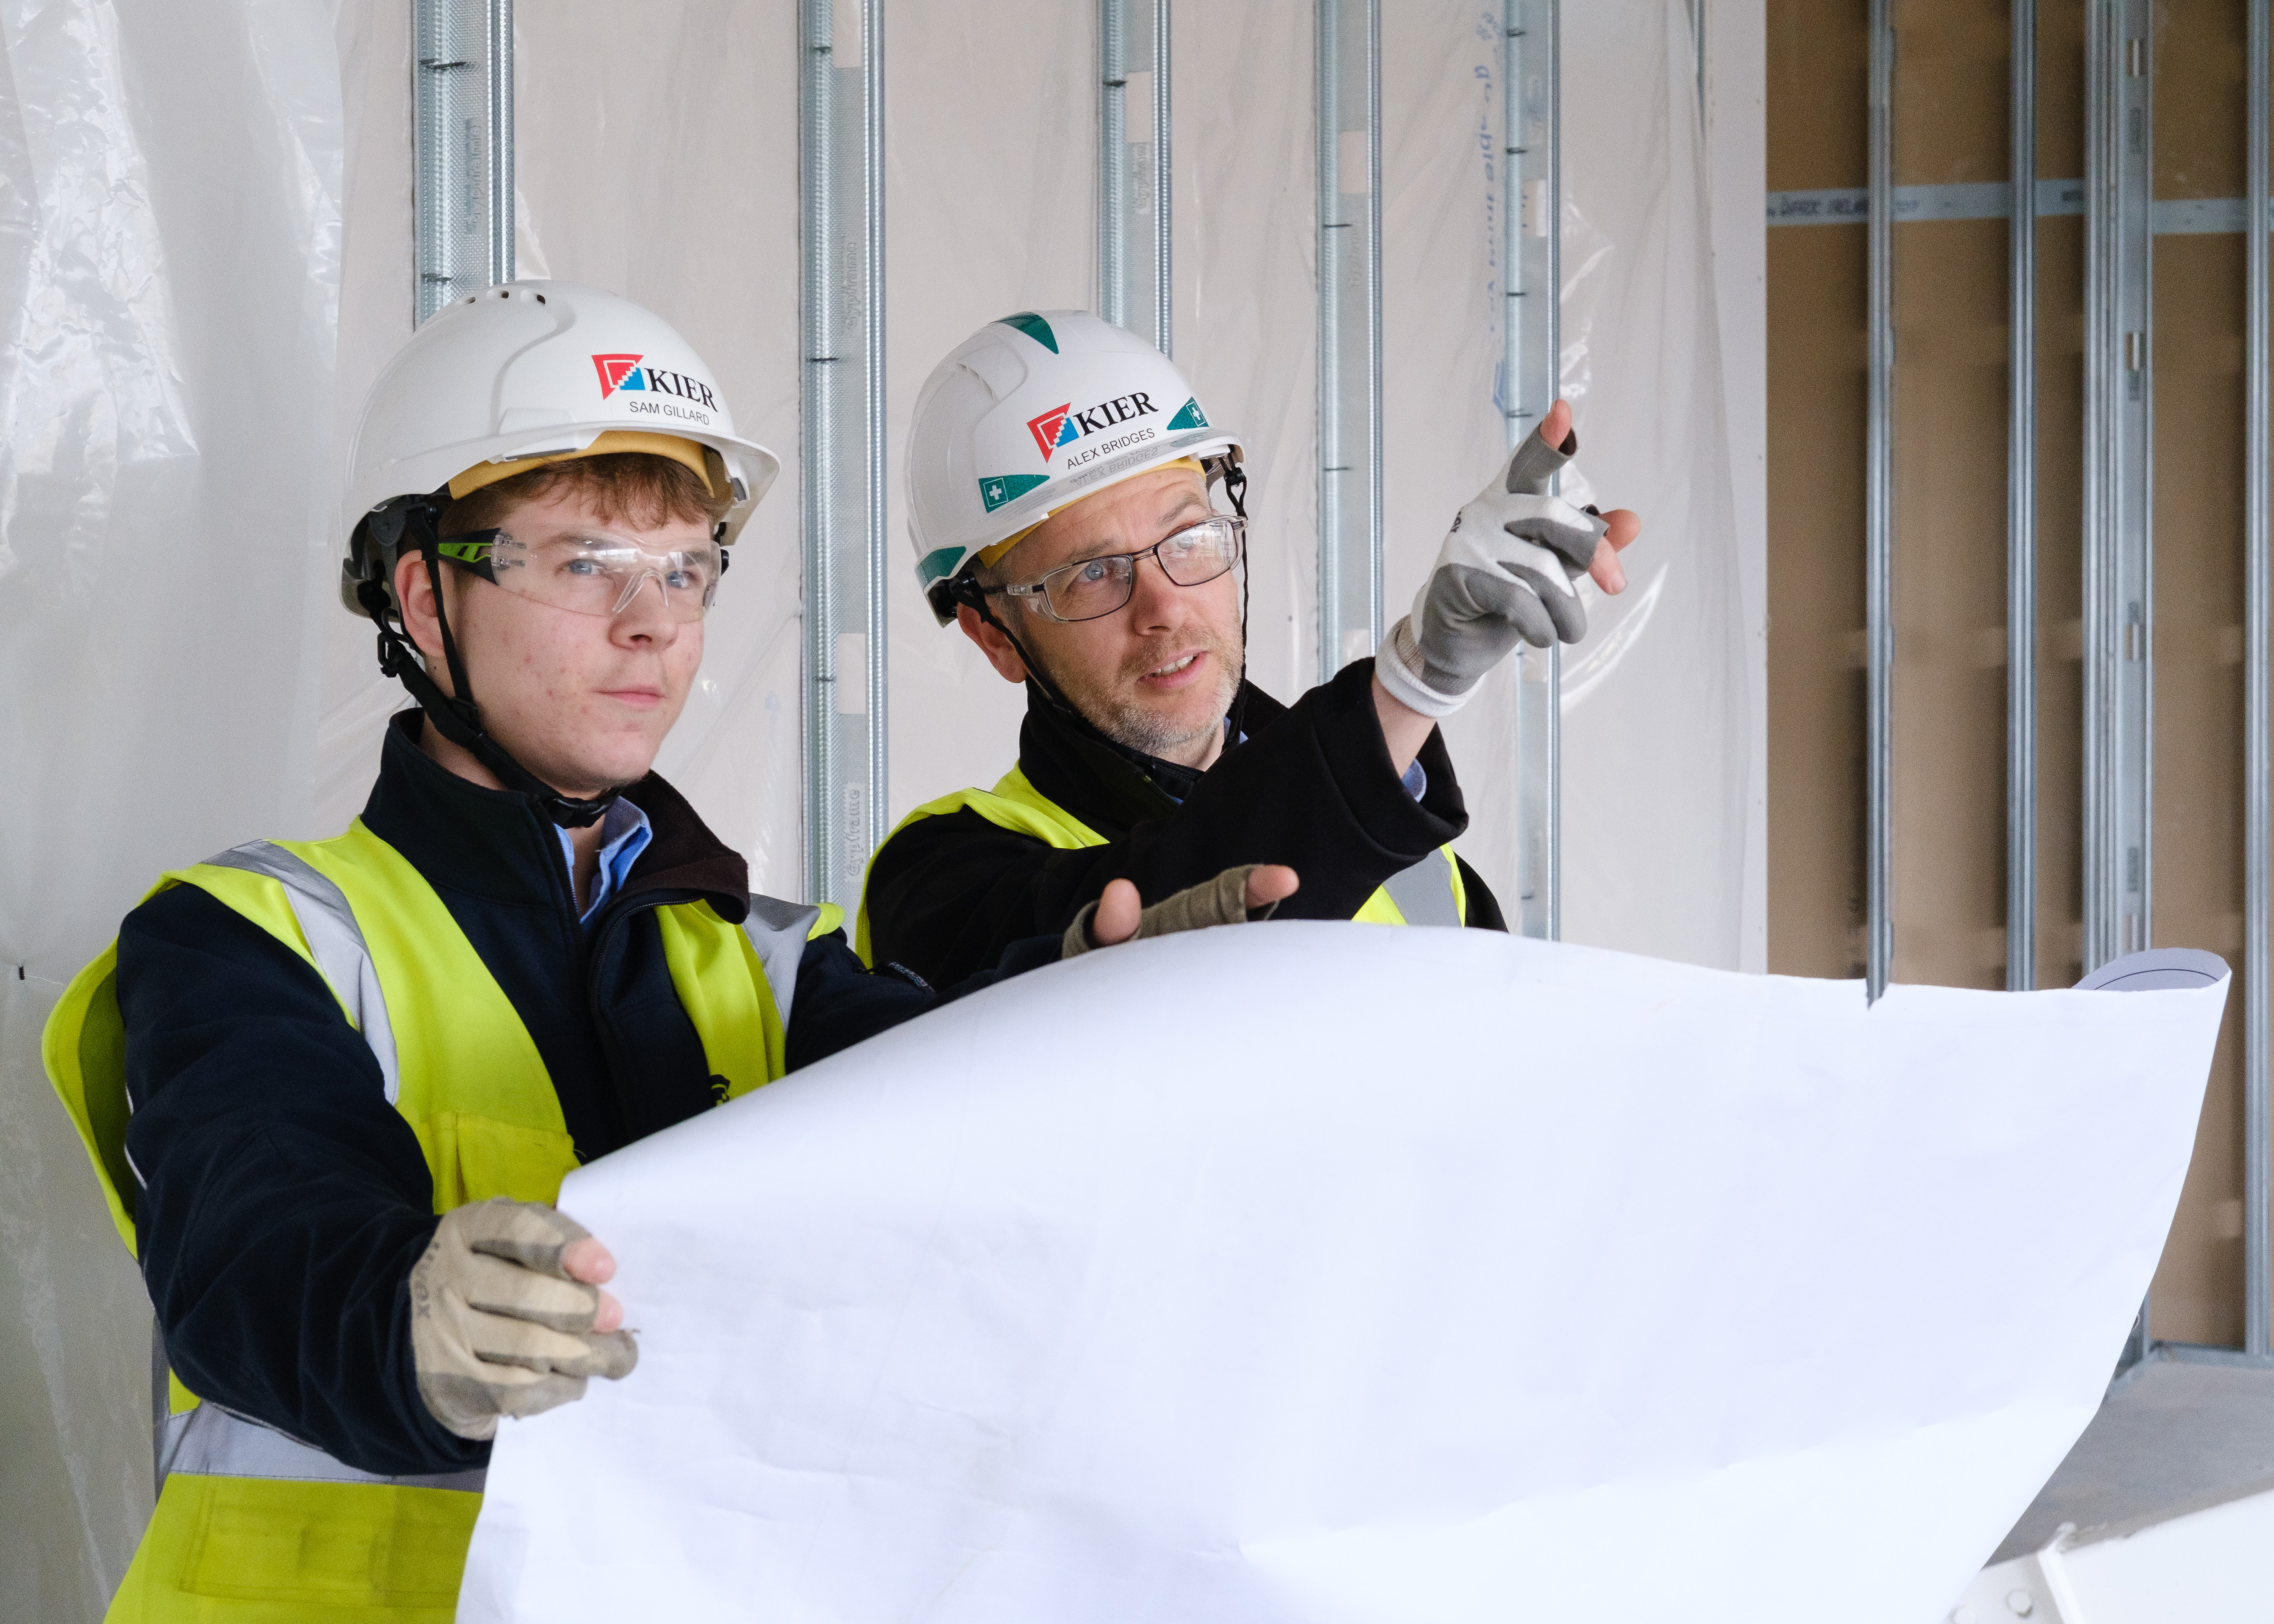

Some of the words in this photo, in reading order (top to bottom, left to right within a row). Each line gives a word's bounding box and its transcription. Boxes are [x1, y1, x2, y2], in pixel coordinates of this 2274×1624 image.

[643, 368, 718, 412] KIER
[630, 401, 659, 414] SAM
[664, 404, 709, 425] GILLARD
[1073, 392, 1158, 436] KIER
[1067, 448, 1100, 469] ALEX
[1102, 428, 1155, 454] BRIDGES
[846, 789, 864, 876] Gypframe
